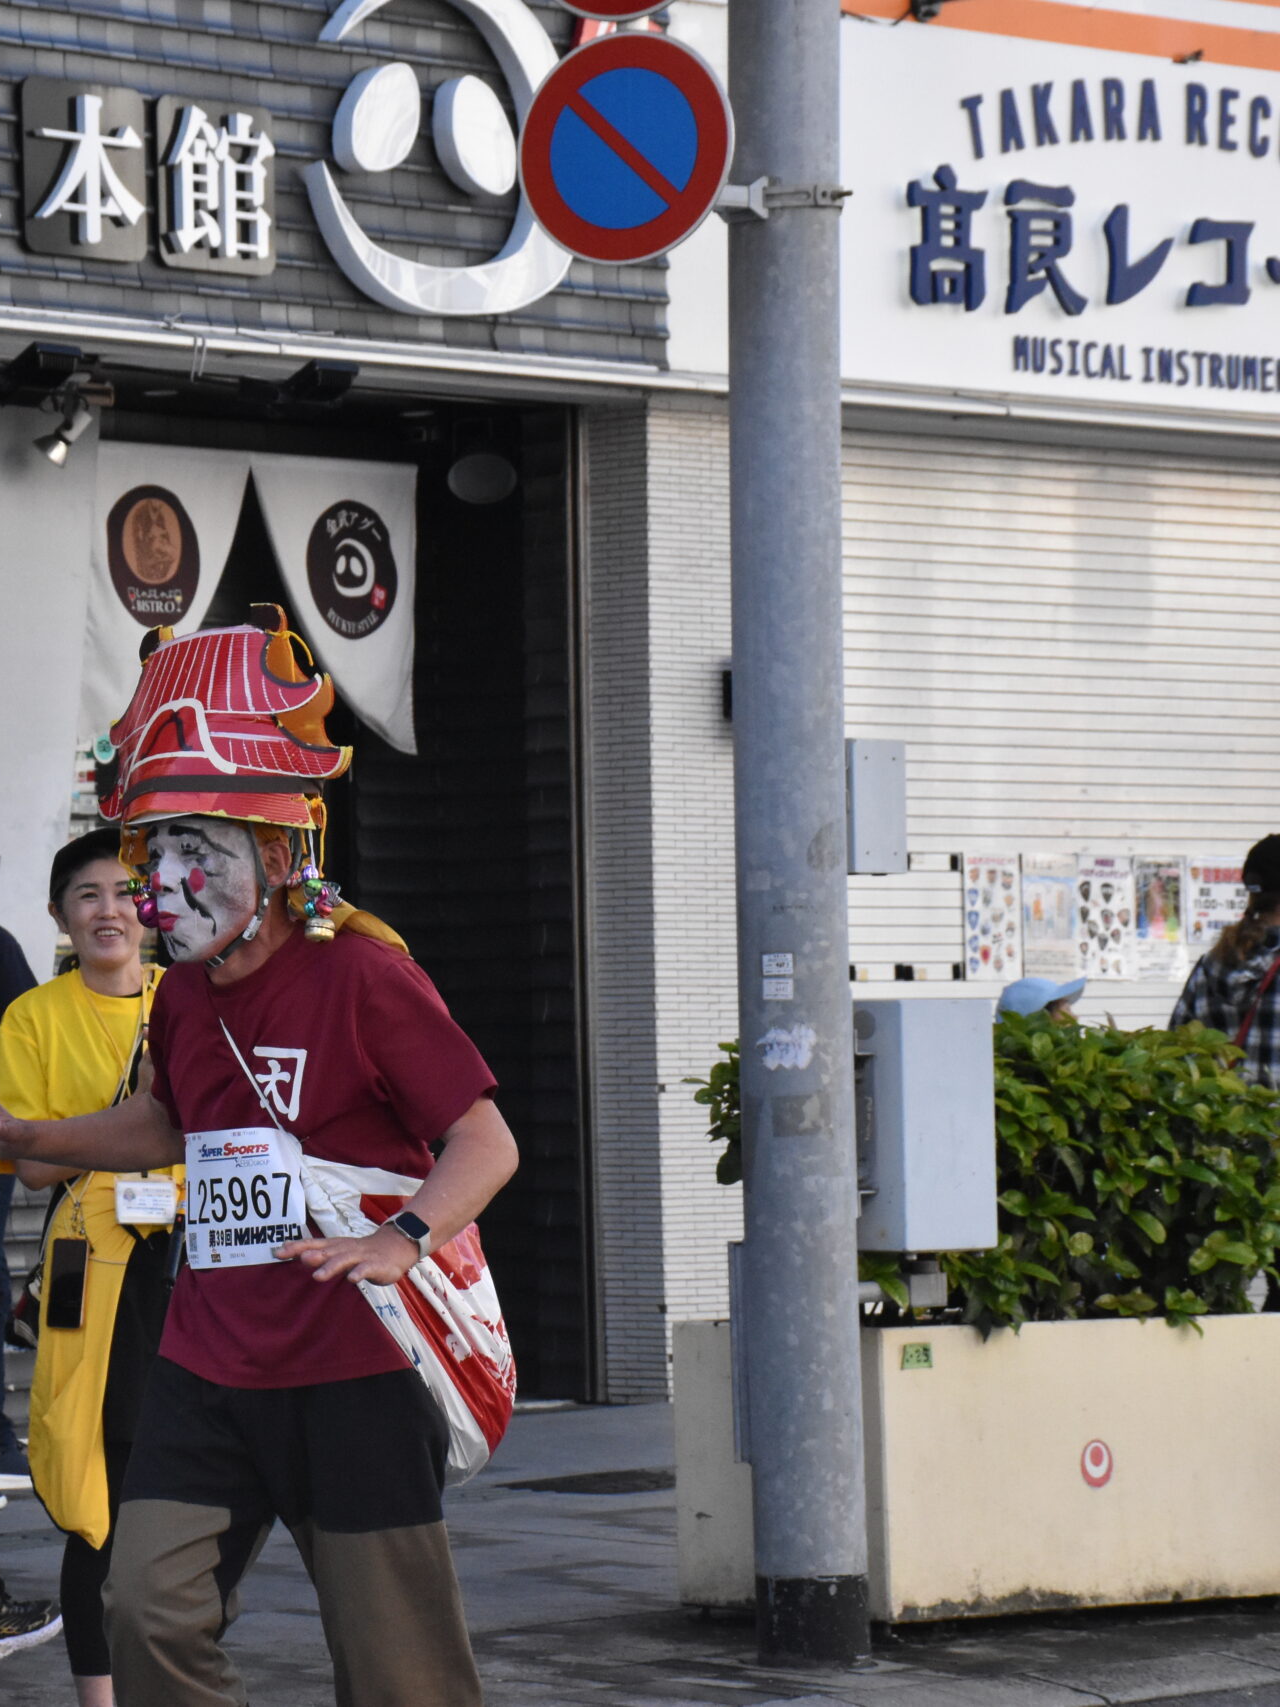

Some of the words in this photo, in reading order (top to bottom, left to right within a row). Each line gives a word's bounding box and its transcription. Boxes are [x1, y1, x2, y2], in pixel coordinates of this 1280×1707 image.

[961, 77, 1160, 159] TAKARA
[1185, 82, 1280, 158] REC
[1013, 335, 1131, 381] MUSICAL
[136, 599, 176, 613] BISTRO
[223, 1142, 270, 1157] SPORTS
[187, 1172, 291, 1225] L25967
